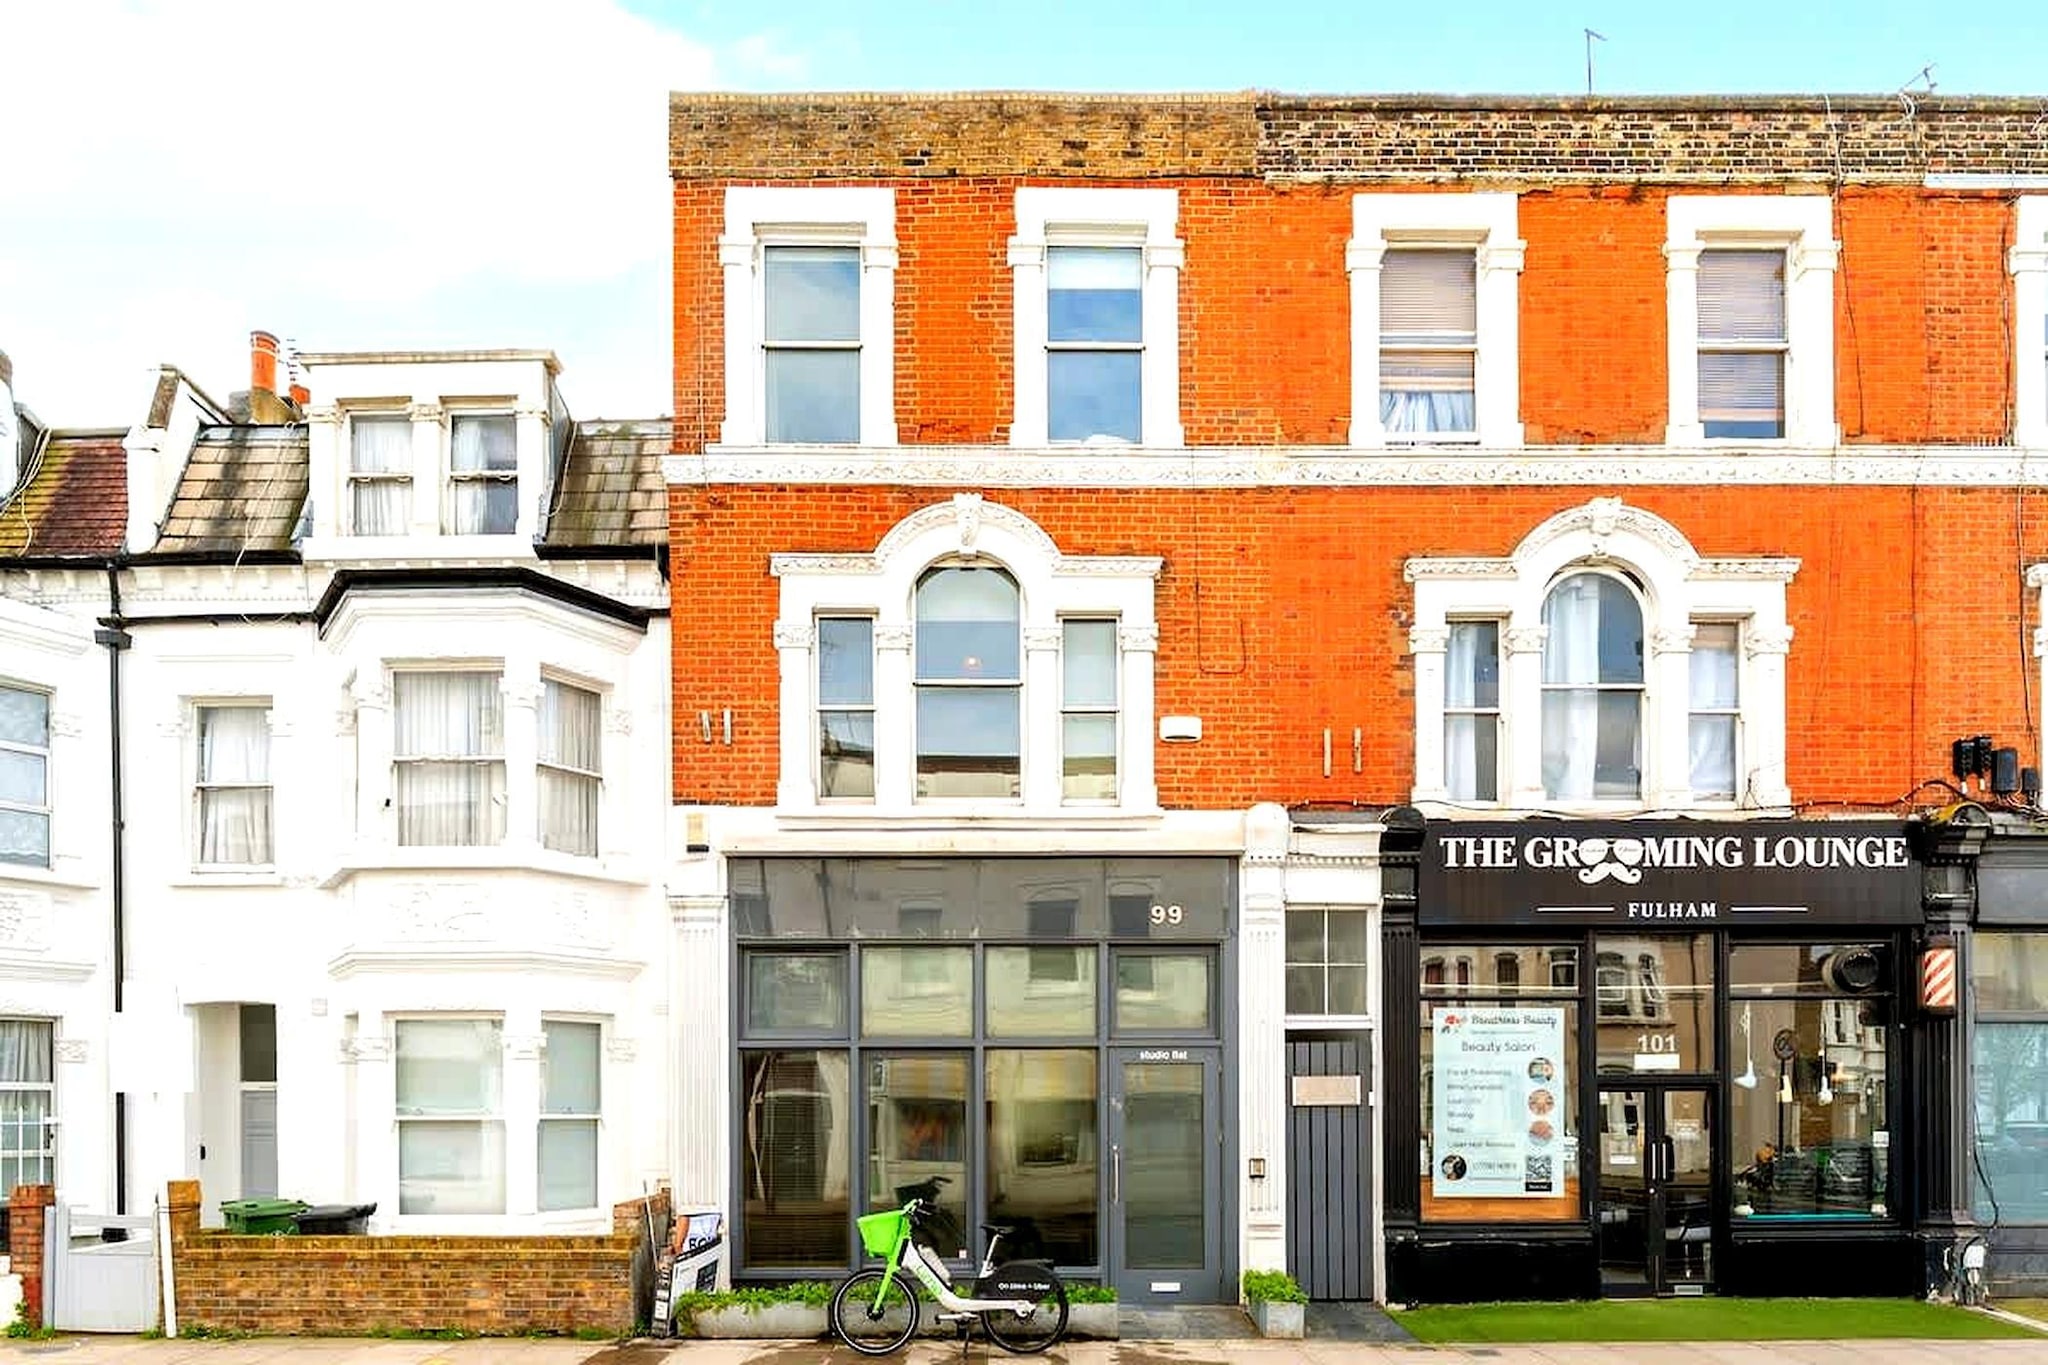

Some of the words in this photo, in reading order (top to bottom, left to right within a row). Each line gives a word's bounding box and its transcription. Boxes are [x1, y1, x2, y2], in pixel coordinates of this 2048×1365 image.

[1439, 836, 1518, 868] THE
[1524, 836, 1744, 868] GROOMING
[1753, 836, 1909, 868] LOUNGE
[1150, 905, 1183, 924] 99
[1628, 902, 1717, 918] FULHAM
[1461, 1041, 1501, 1055] Beauty
[1504, 1041, 1536, 1052] Salon
[1637, 1034, 1677, 1052] 101
